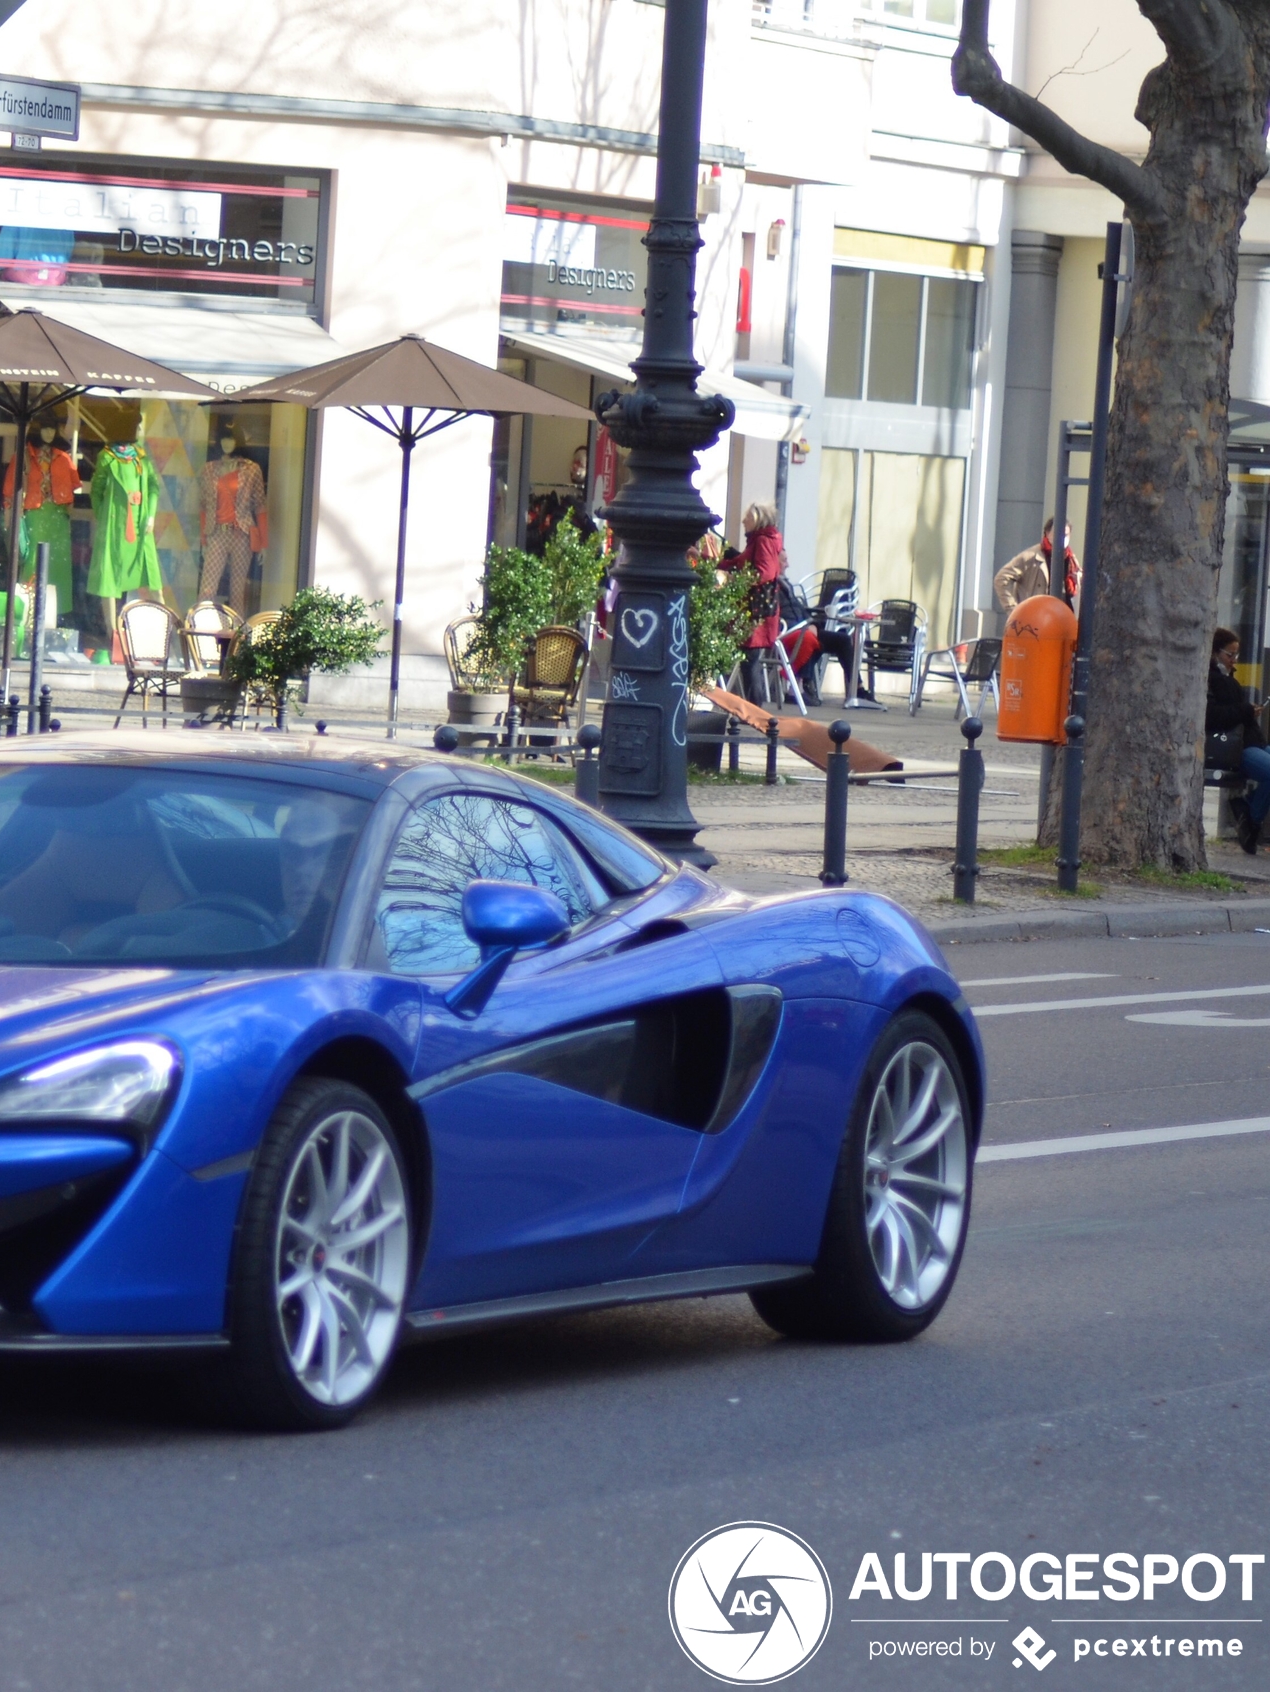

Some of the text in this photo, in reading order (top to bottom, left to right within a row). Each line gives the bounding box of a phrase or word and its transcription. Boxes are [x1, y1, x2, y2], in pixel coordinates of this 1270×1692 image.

[7, 186, 202, 226] Italian
[117, 227, 314, 266] Designers
[548, 259, 636, 296] Designers
[86, 371, 156, 384] KAFFEE
